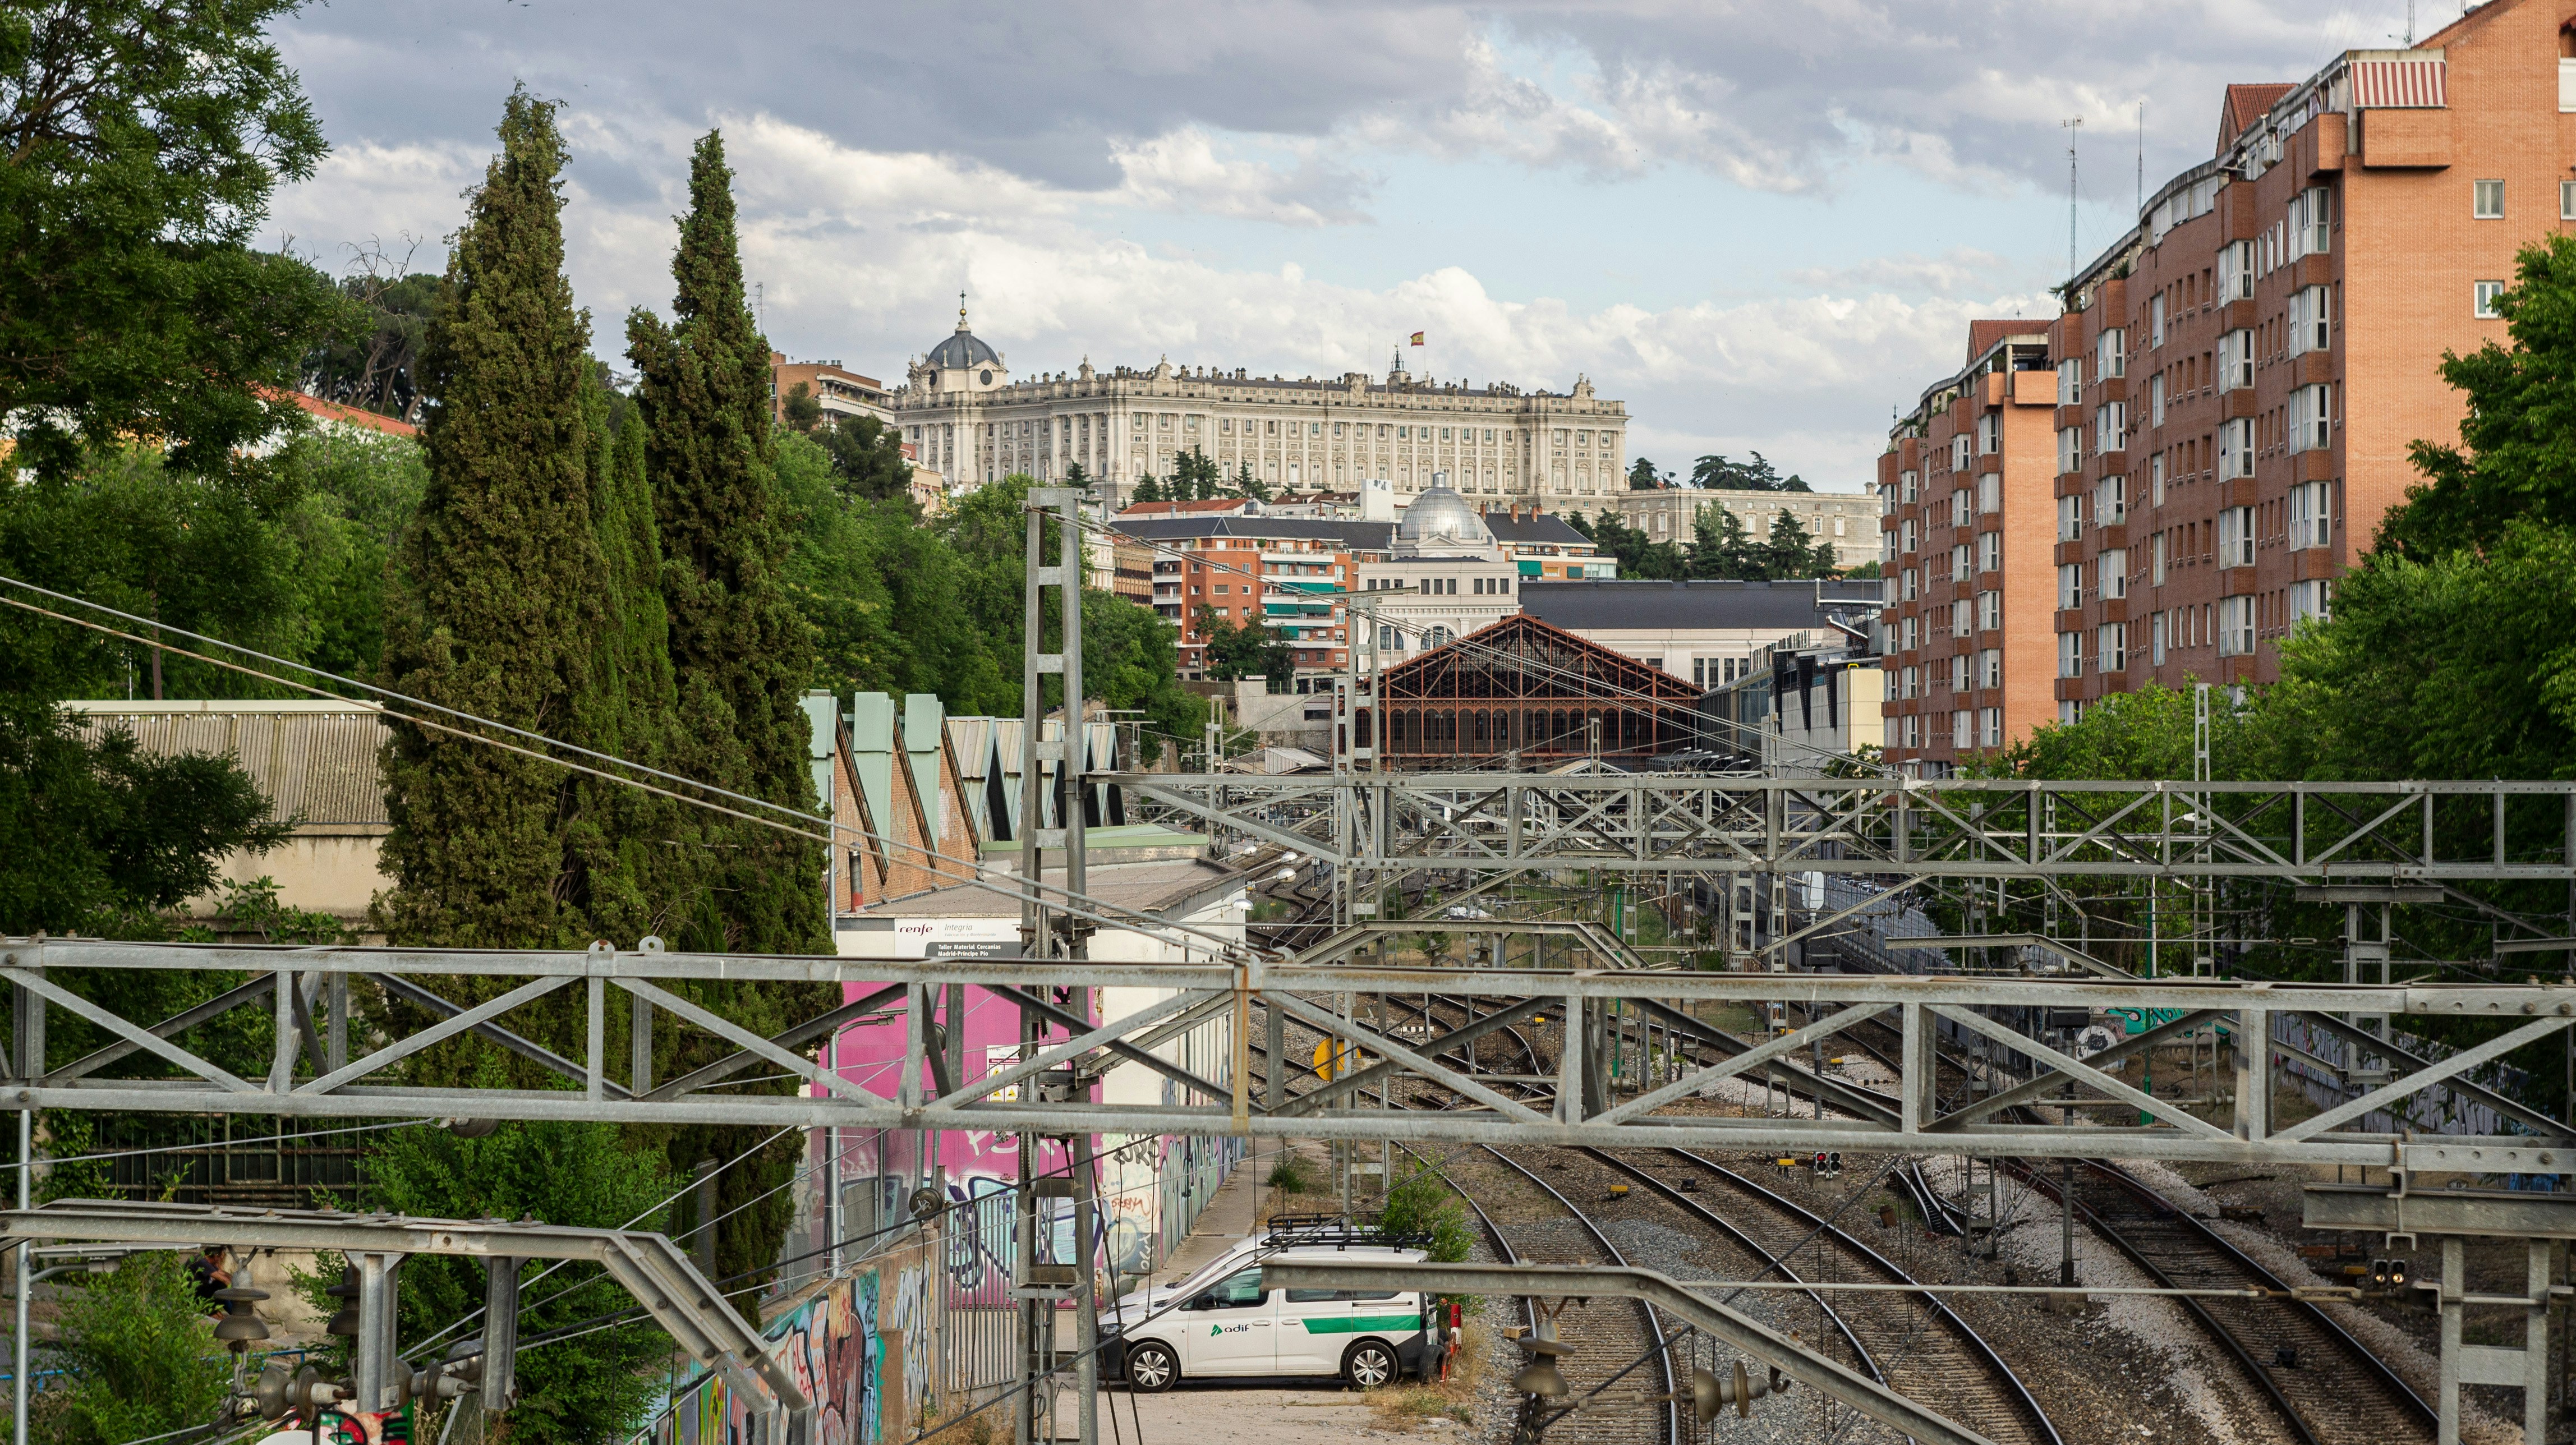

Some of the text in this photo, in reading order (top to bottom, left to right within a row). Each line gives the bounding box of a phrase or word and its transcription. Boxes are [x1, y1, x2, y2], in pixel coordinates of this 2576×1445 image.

[900, 923, 933, 936] renfe
[945, 923, 973, 933] Integria
[1225, 1324, 1250, 1332] adif
